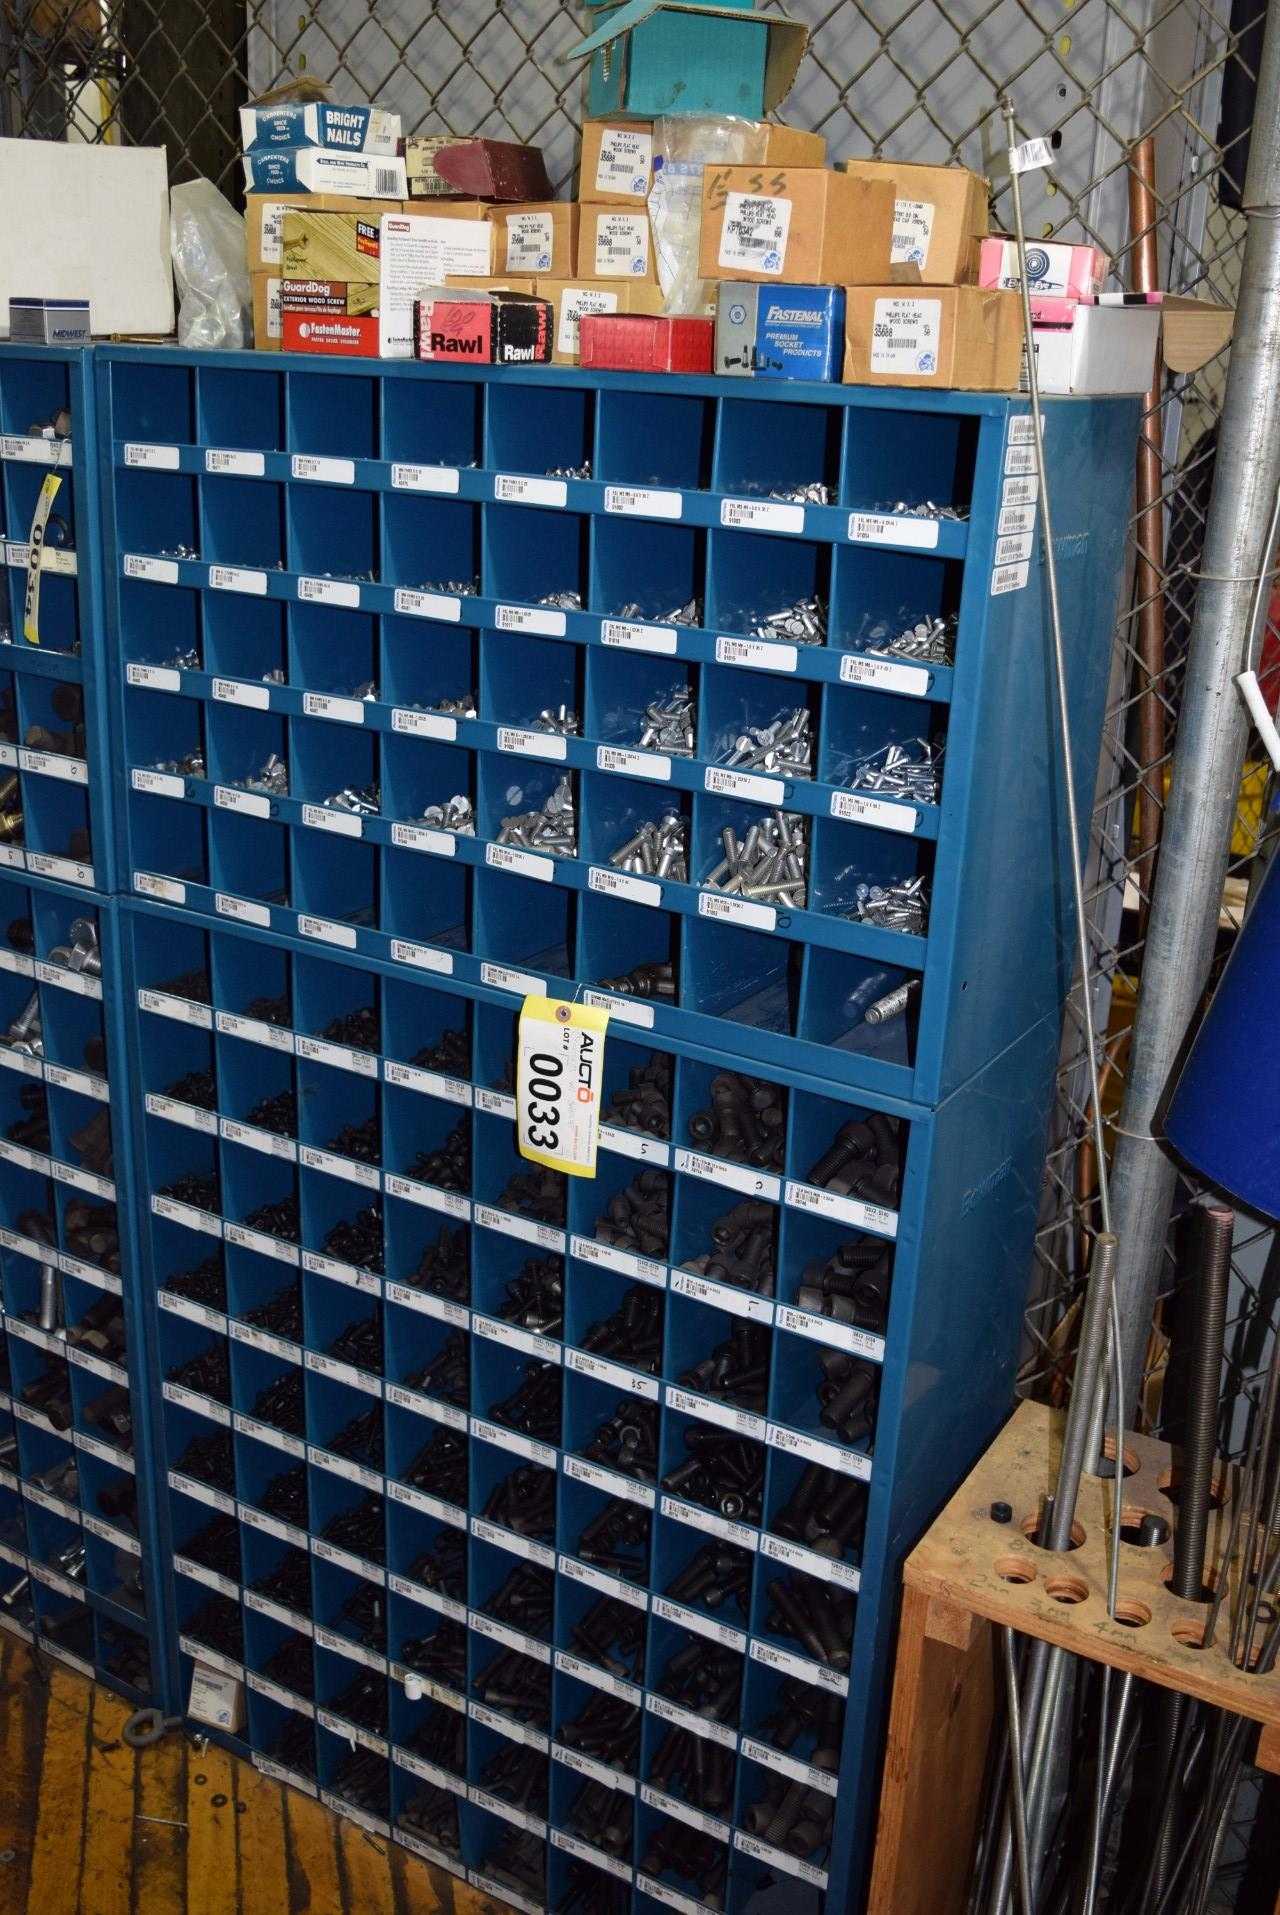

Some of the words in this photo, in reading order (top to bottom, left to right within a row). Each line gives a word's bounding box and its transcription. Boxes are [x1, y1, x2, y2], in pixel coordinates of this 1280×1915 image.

[326, 110, 365, 128] BRIGHT
[326, 128, 362, 147] NAILS
[358, 224, 375, 238] FREE
[284, 281, 330, 296] GuardDog
[284, 296, 307, 304] EXTERIOR
[767, 306, 823, 322] FASTENAL
[431, 332, 483, 354] Rawl
[774, 340, 802, 348] SOCKET
[504, 345, 534, 361] Rawl
[783, 349, 822, 357] PRODUCTS
[562, 1027, 570, 1043] LOT
[527, 1053, 563, 1150] 0033
